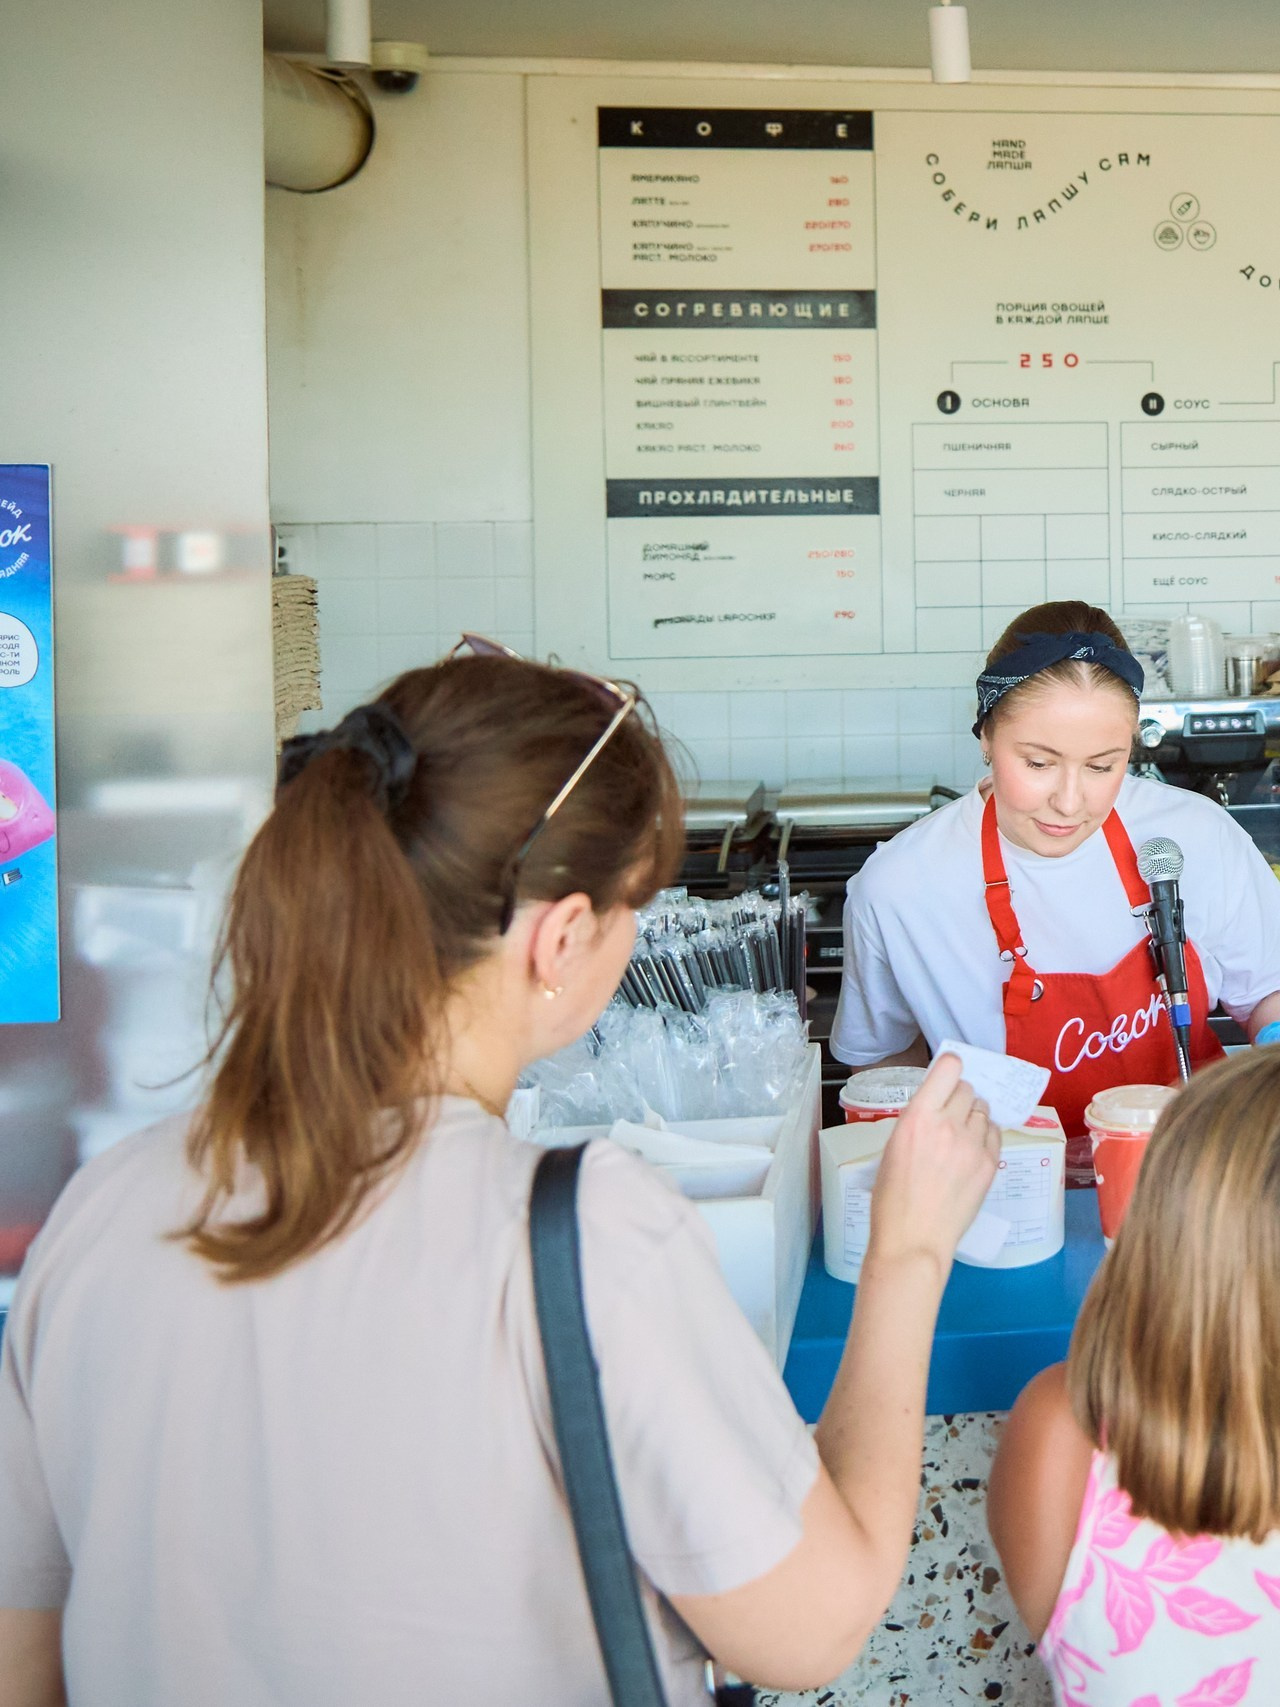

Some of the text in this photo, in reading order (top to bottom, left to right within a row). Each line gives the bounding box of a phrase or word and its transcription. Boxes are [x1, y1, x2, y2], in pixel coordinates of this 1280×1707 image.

[630, 120, 849, 138] КОФЕ
[992, 140, 1026, 149] HAND
[992, 150, 1026, 159] MADE
[986, 160, 1032, 171] ЛАПША
[926, 153, 1151, 230] СОБЕРИ ЛАПШУ САМ
[634, 302, 850, 320] СОГРЕВАЮЩИЕ
[996, 300, 1105, 313] ПОРЦИЯ ОВОЩЕЙ
[1007, 312, 1063, 325] КАЖДОЙ
[1066, 315, 1109, 324] ЛАПШЕ
[1020, 353, 1079, 368] 250
[972, 398, 1030, 408] ОСНОВА
[1174, 399, 1210, 409] СОУС
[943, 442, 1012, 451] ПШЕНИЧНАЯ
[1151, 440, 1199, 451] СЫРНЫЙ
[944, 488, 986, 497] ЧЕРНАЯ
[1152, 486, 1247, 497] СЛАДКО-ОСТРЫЙ
[638, 489, 854, 506] ПРОХЛАДИТЕЛЬНЫЕ
[1152, 530, 1247, 541] КИСЛО-СЛАДКИЙ
[1179, 577, 1208, 585] СОУС
